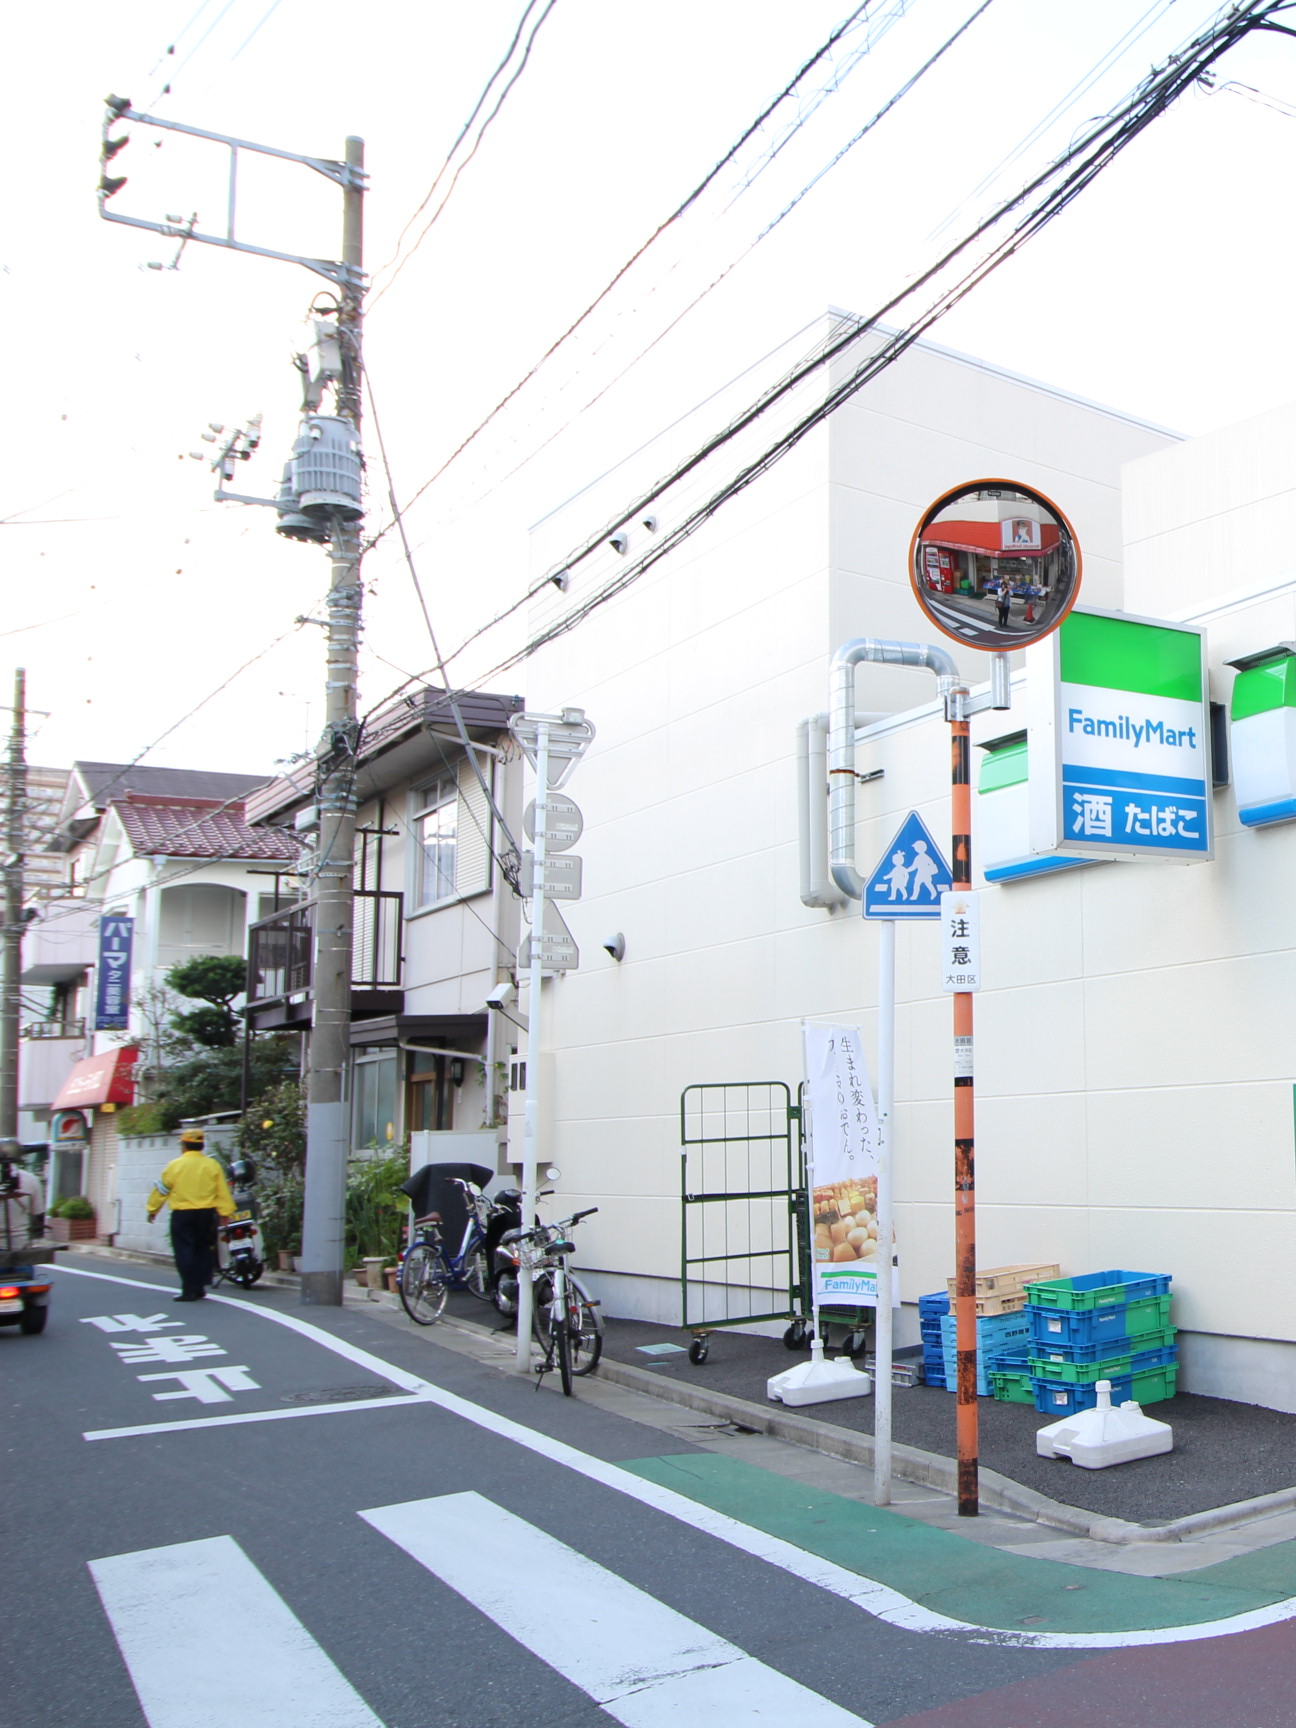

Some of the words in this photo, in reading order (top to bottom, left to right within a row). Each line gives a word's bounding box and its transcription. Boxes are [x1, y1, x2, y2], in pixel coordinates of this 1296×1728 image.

[1068, 708, 1197, 749] FamilyMart
[1072, 792, 1113, 838] 酒
[1124, 803, 1200, 839] たばこ
[950, 918, 972, 965] 注意
[945, 974, 977, 984] 大田区
[840, 1036, 874, 1160] 生まれ変わった、
[824, 1279, 877, 1293] FamilyMa
[78, 1312, 263, 1405] 止まれ
